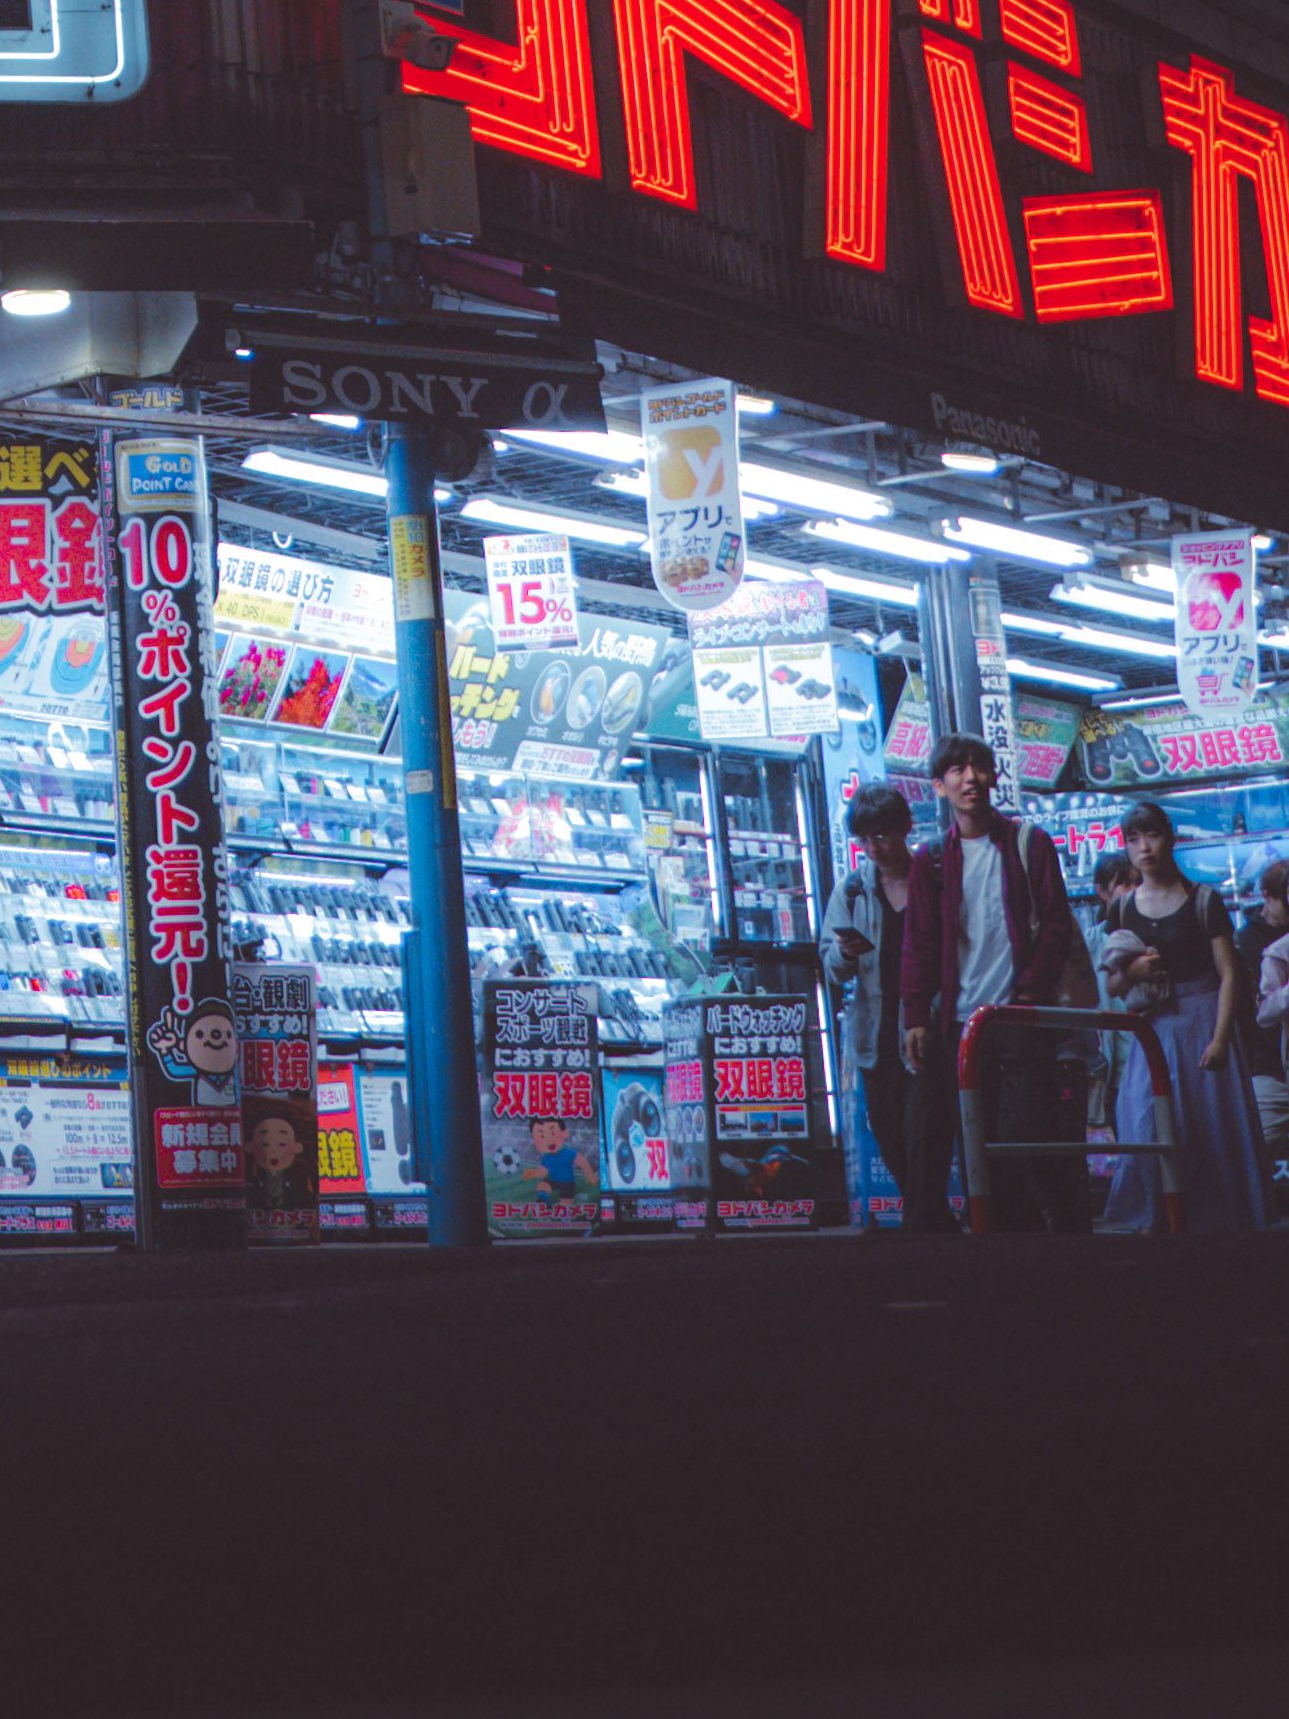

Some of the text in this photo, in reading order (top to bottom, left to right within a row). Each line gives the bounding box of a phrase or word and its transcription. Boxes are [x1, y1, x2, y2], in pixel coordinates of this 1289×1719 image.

[111, 389, 184, 411] ゴールド
[281, 359, 490, 419] SONY
[929, 391, 1043, 457] Panasonic
[655, 505, 734, 535] アプリで
[221, 557, 336, 604] 双眼鏡の選び方
[511, 556, 567, 577] 双眼鏡
[495, 580, 573, 627] 15%
[984, 696, 1011, 751] 水没
[1158, 724, 1283, 774] 双眼鏡
[495, 989, 588, 1016] コンサート
[495, 1015, 589, 1045] スポーツ観戦
[706, 1003, 806, 1034] バードウォッチング
[495, 1047, 591, 1068] におすすめ!
[714, 1036, 802, 1056] におすすめ!
[491, 1070, 594, 1119] 双眼鏡
[713, 1059, 808, 1102] 双眼鏡
[172, 1148, 239, 1177] 募集中
[491, 1201, 597, 1221] ヨドバシカメラ
[716, 1199, 815, 1218] ヨドバシカメラ
